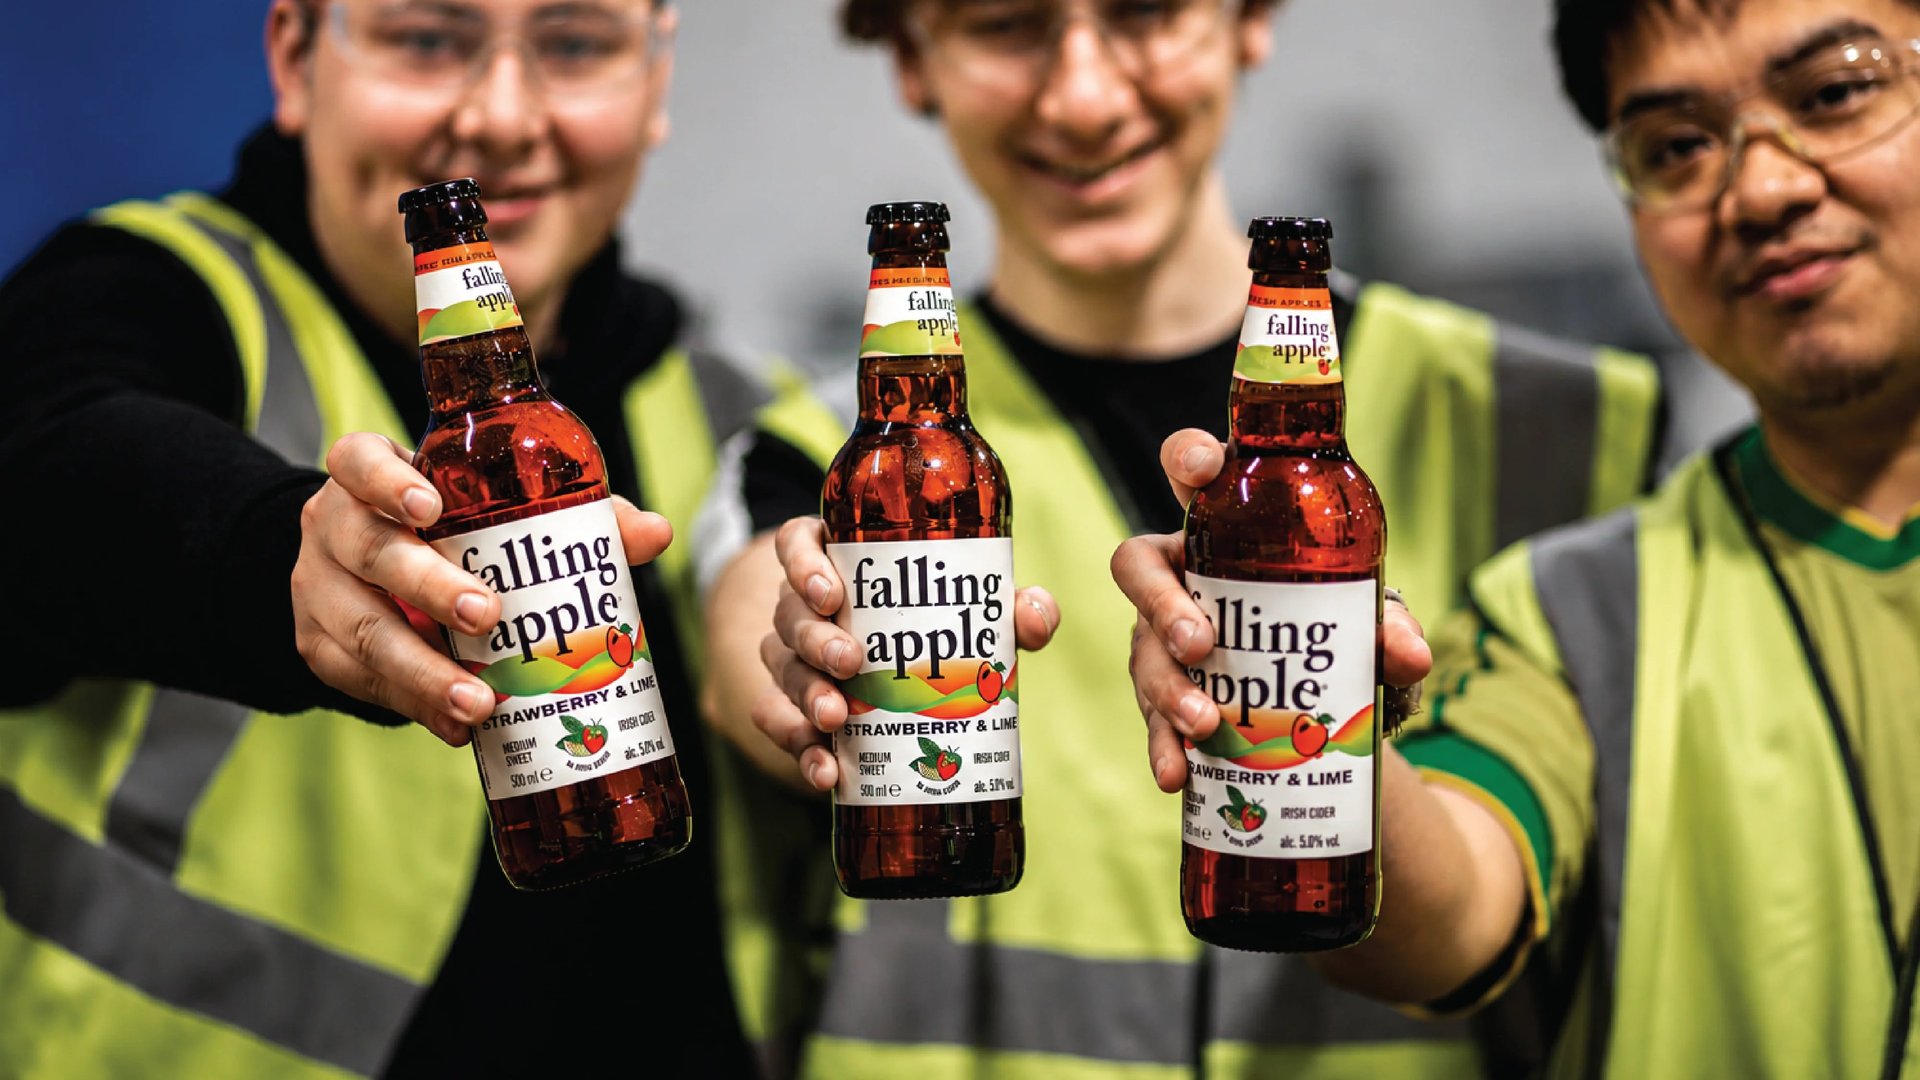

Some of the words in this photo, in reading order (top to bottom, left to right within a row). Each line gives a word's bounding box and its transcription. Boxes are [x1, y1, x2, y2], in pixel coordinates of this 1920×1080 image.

[1266, 313, 1329, 343] falling
[1272, 337, 1326, 364] apple
[853, 555, 1003, 621] falling
[488, 576, 618, 664] apple
[1192, 591, 1338, 672] lling
[866, 608, 996, 680] apple
[482, 689, 610, 731] STRAWBERRY
[615, 684, 628, 698] &
[631, 675, 656, 695] LIME
[844, 720, 971, 736] STRAWBERRY
[976, 719, 988, 732] &
[992, 717, 1017, 731] LIME
[502, 737, 538, 755] MEDIUM
[505, 752, 533, 767] SWEET
[859, 752, 891, 764] MEDIUM
[859, 764, 886, 776] SWEET
[1188, 761, 1280, 786] RAWBERRY
[1287, 773, 1301, 786] &
[1307, 769, 1353, 786] LIME
[860, 784, 875, 797] 500
[876, 784, 887, 797] ml
[1280, 808, 1306, 819] IRISH
[1309, 807, 1336, 819] CIDER
[1280, 834, 1297, 849] alc.
[1299, 834, 1323, 849] 5.0%
[1325, 833, 1340, 847] vol
